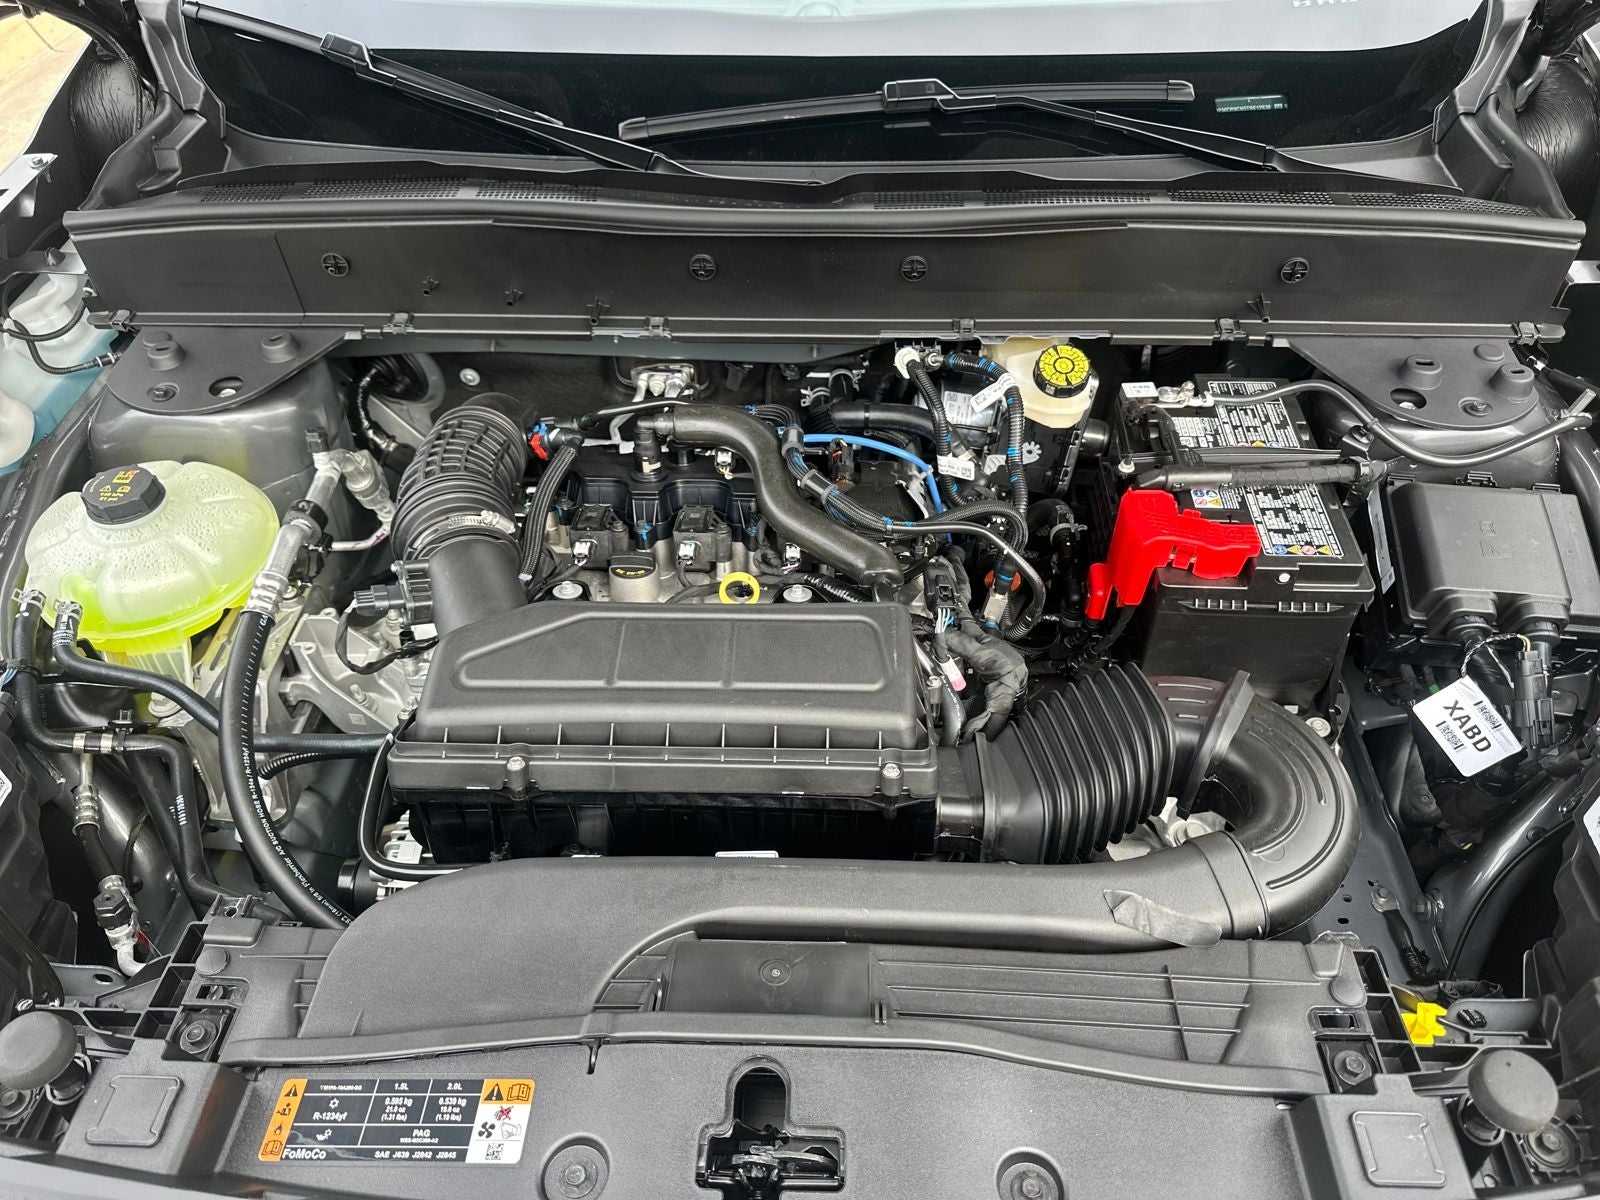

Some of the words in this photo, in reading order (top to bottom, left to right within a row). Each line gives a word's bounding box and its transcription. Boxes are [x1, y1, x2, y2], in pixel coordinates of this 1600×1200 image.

[1443, 700, 1491, 752] XABD
[242, 747, 252, 774] R-1234yf
[253, 800, 265, 818] HOSE
[261, 818, 279, 845] SUCTION
[275, 843, 286, 856] A/C
[284, 857, 310, 888] Flexbarrier
[394, 1082, 409, 1091] 1.5L
[446, 1082, 463, 1091] 2.0L
[403, 1097, 414, 1108] kg
[438, 1097, 458, 1106] 0.539
[457, 1097, 468, 1108] kg
[312, 1111, 348, 1122] R-1234yf
[412, 1128, 431, 1138] PAG
[282, 1148, 327, 1160] FoMoCo
[374, 1150, 391, 1159] SAE
[392, 1150, 410, 1159] J639
